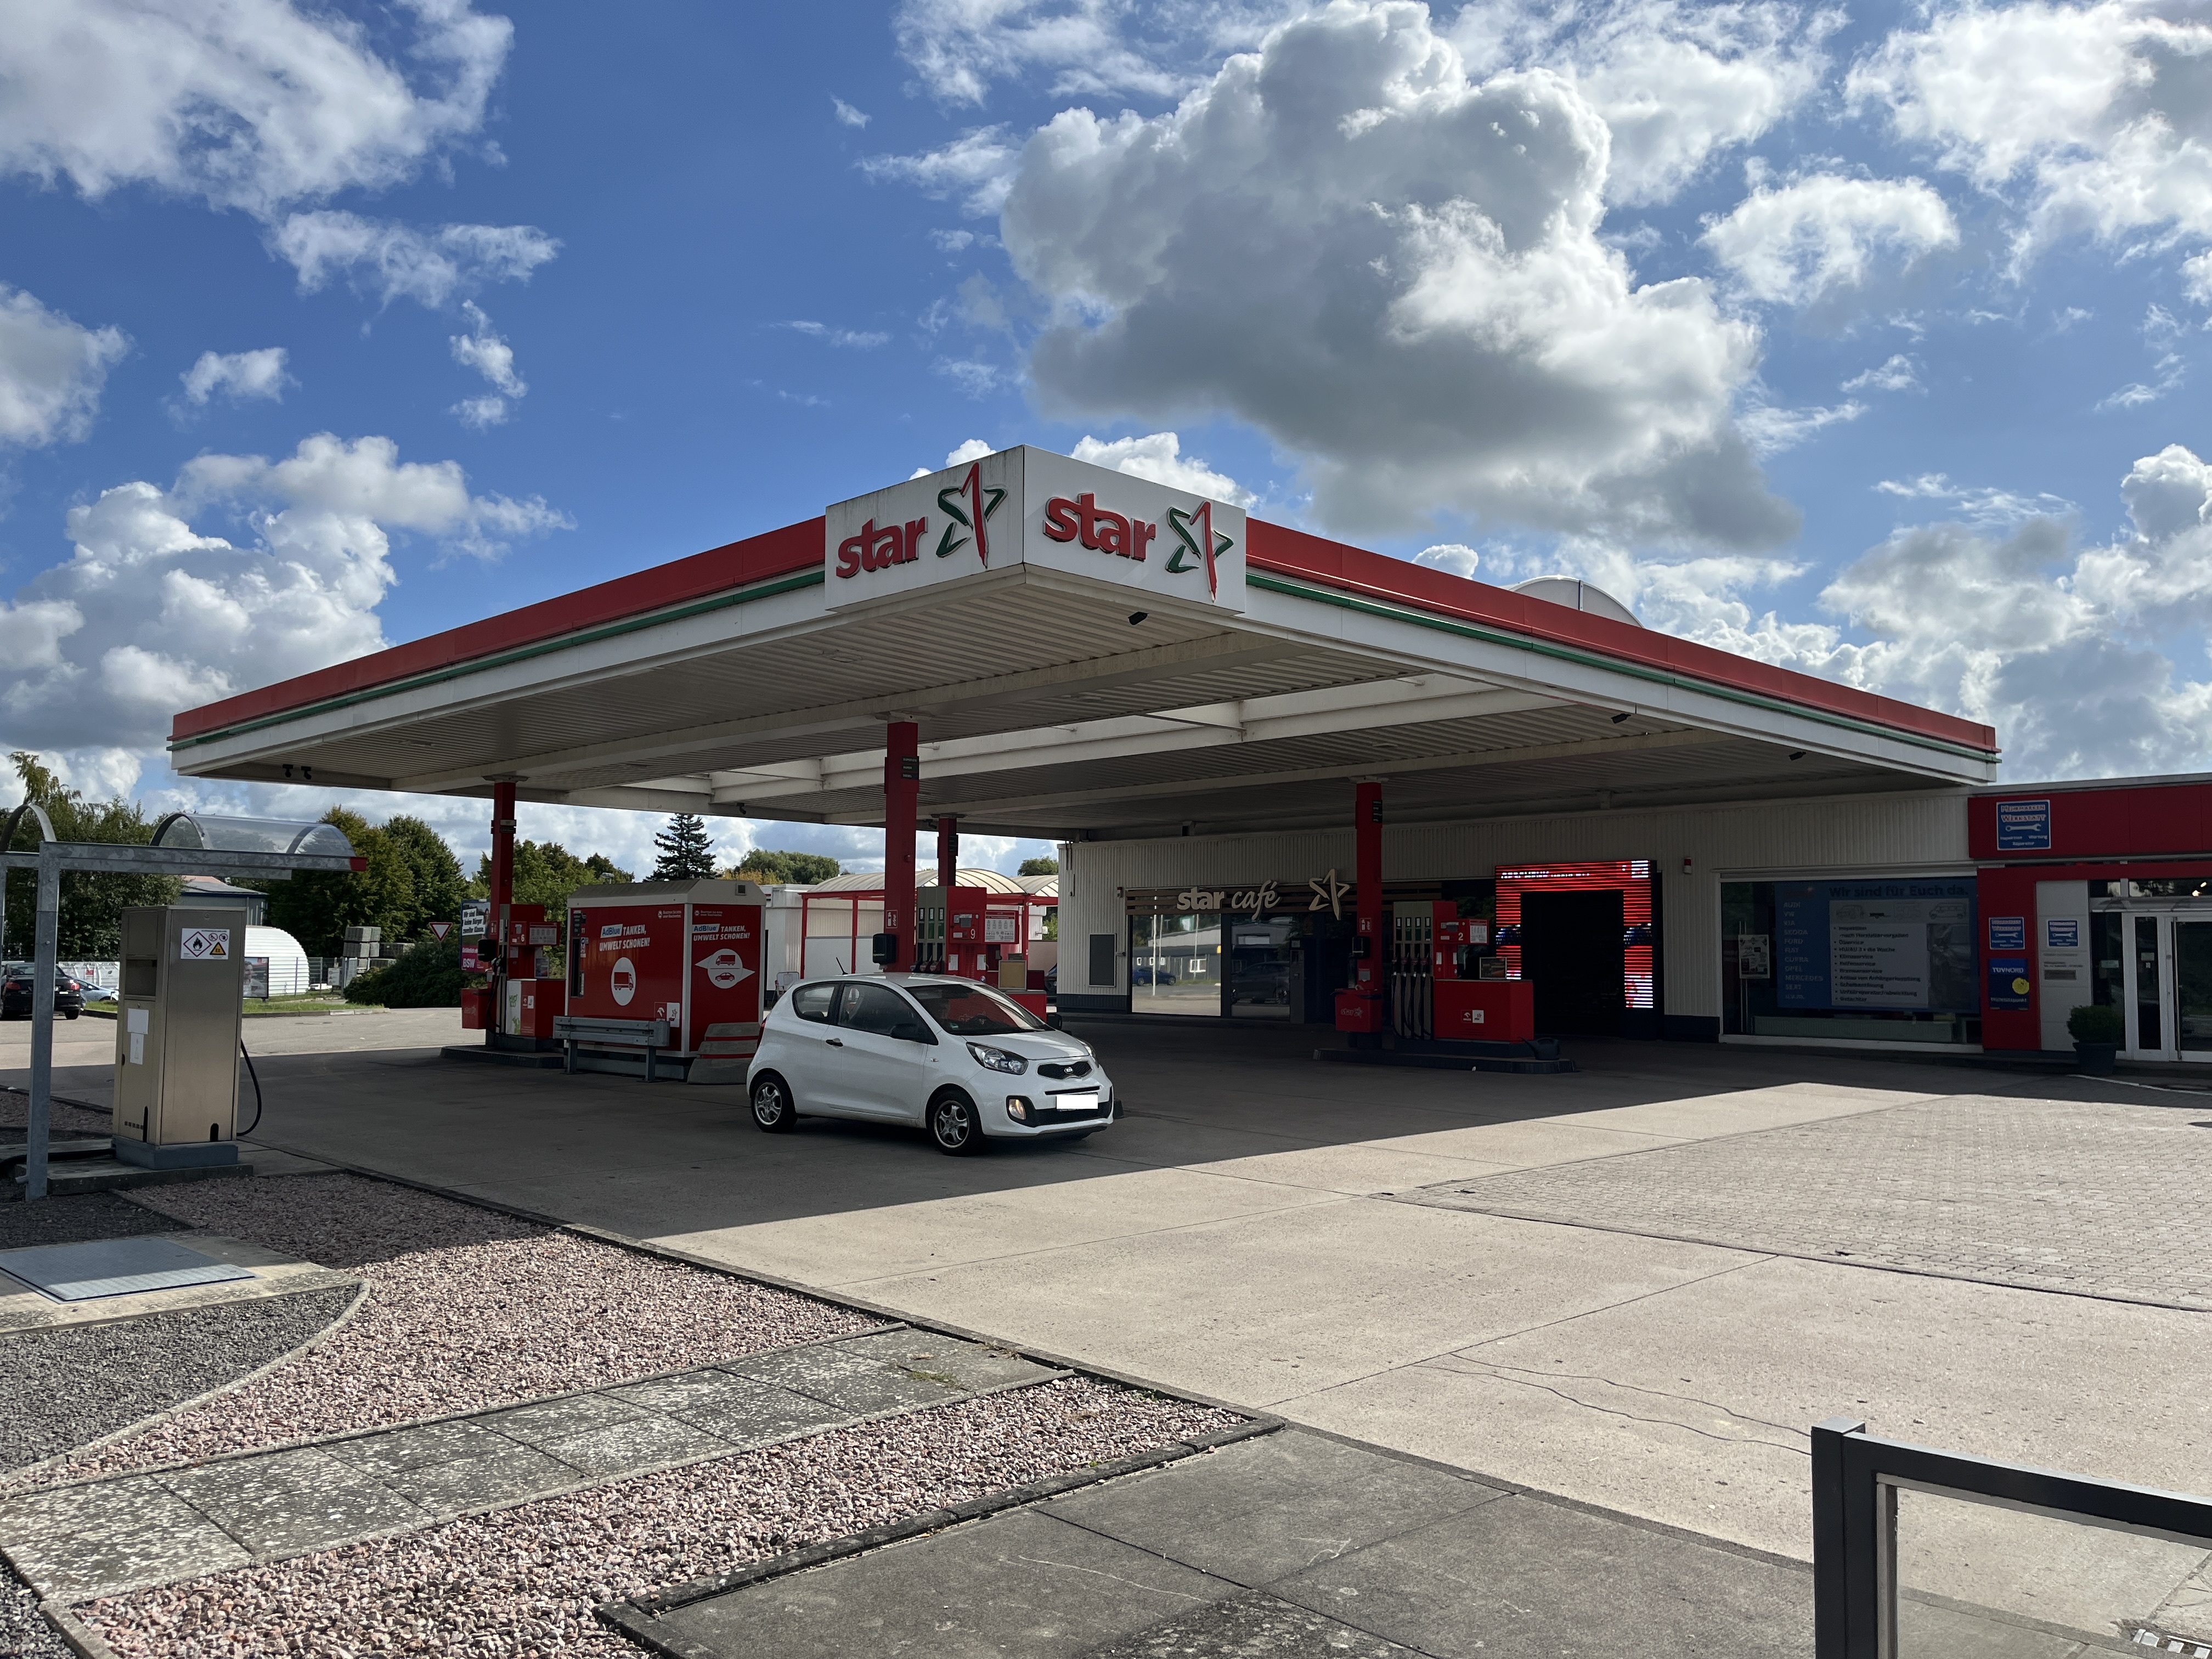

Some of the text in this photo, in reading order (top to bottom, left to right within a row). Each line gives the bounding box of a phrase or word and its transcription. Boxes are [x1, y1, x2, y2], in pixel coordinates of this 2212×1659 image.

[1043, 492, 1156, 562] star
[836, 516, 927, 579] star
[1830, 884, 1968, 896] Wir sind für Euch da.
[1177, 879, 1281, 920] star café
[602, 924, 646, 936] AdBlue TANKEN,
[970, 929, 975, 939] 9
[1458, 933, 1463, 941] 2
[599, 937, 650, 951] UMWELT SCHONEN!
[463, 958, 475, 968] BSW
